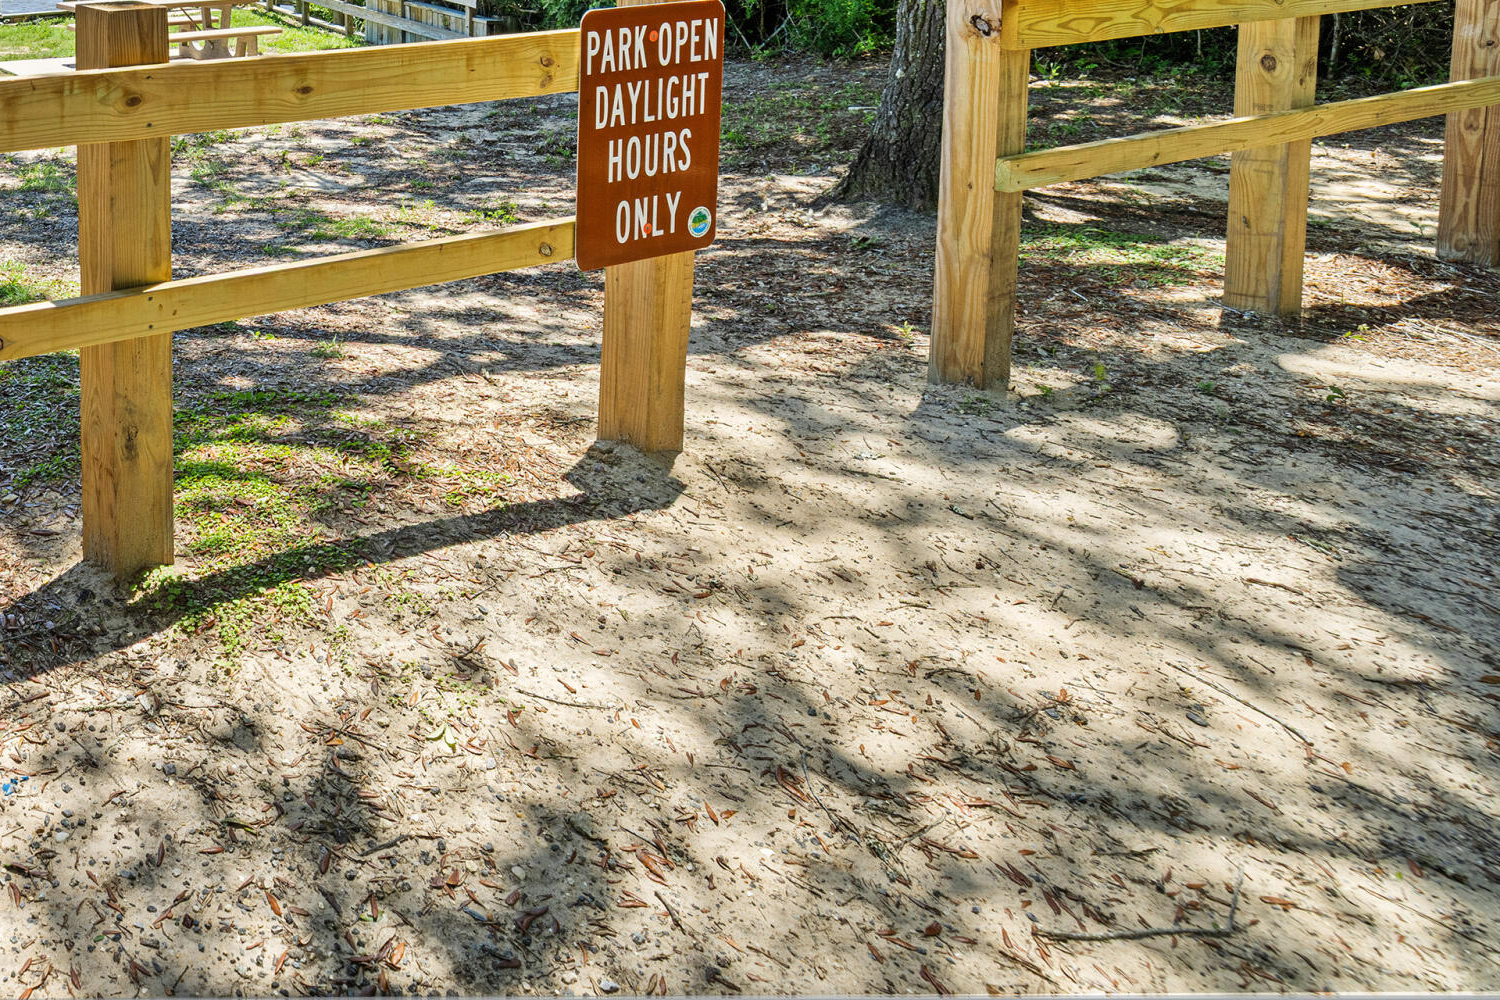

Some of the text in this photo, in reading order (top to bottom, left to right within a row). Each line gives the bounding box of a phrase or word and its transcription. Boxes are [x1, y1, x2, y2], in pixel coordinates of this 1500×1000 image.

[586, 17, 718, 76] PARK OPEN
[595, 72, 709, 130] DAYLIGHT
[608, 128, 692, 183] HOURS
[615, 191, 682, 244] ONLY
